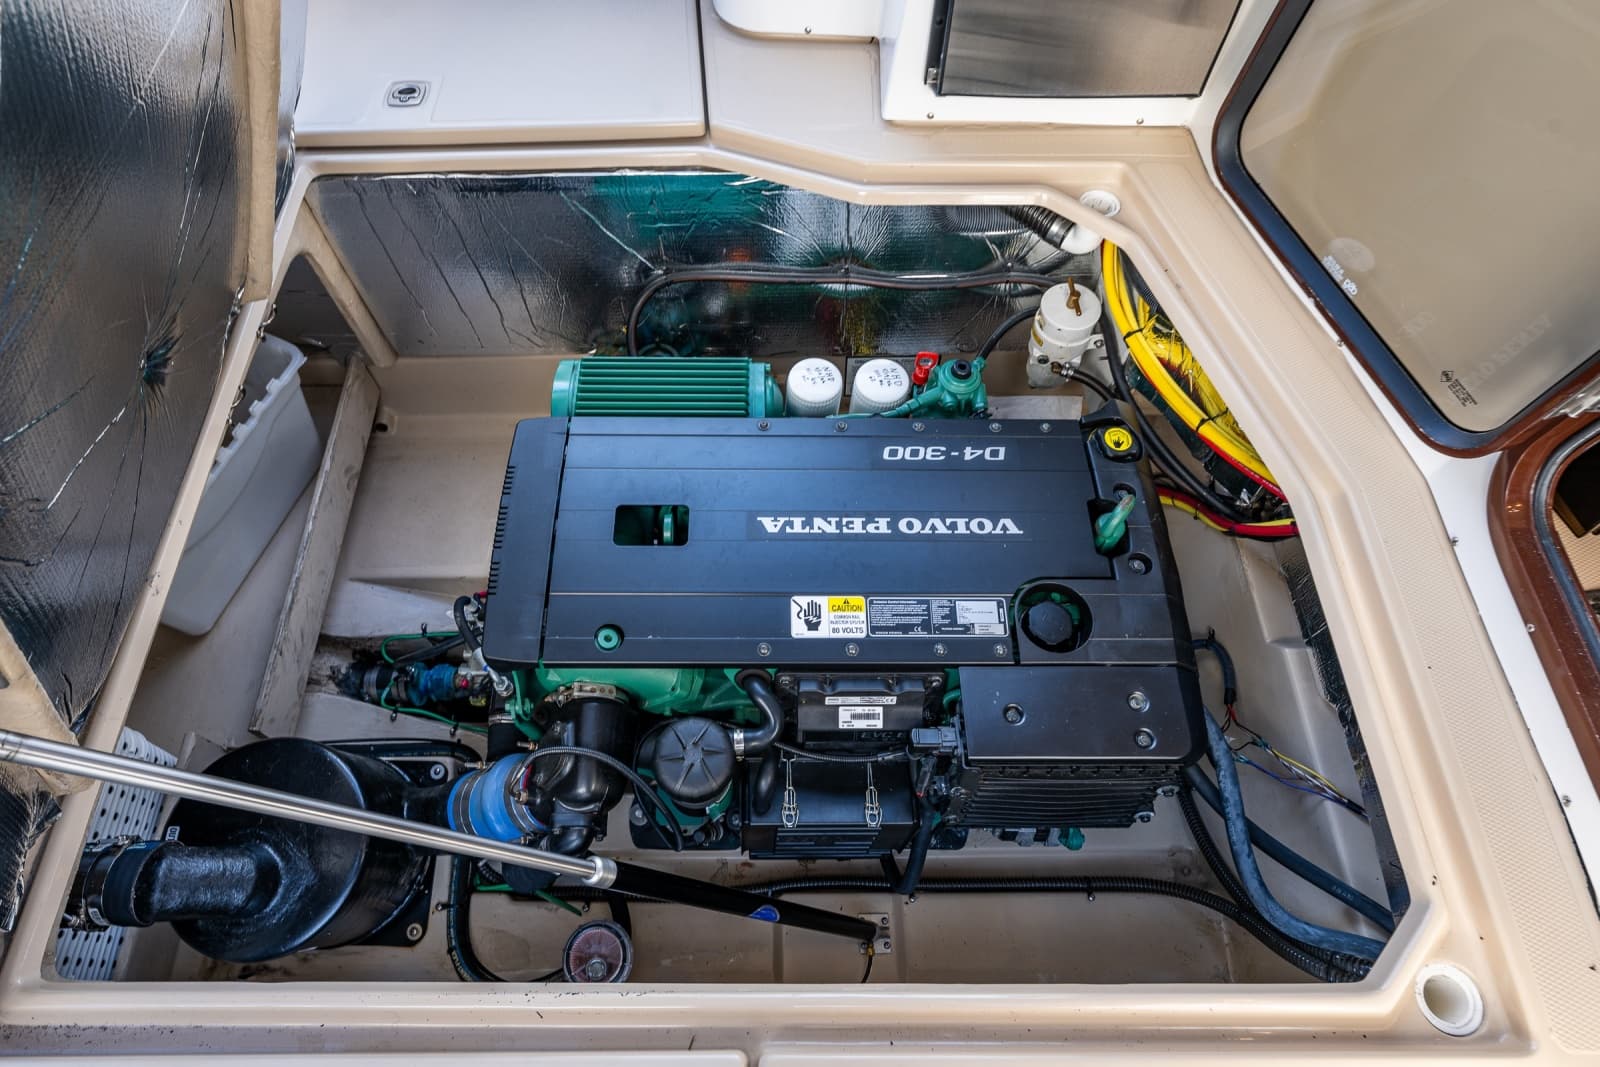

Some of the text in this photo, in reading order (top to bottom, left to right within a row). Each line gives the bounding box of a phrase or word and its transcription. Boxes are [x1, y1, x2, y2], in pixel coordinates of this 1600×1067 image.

[883, 446, 1006, 461] D4-300
[756, 516, 1024, 535] VOLVO PENTA
